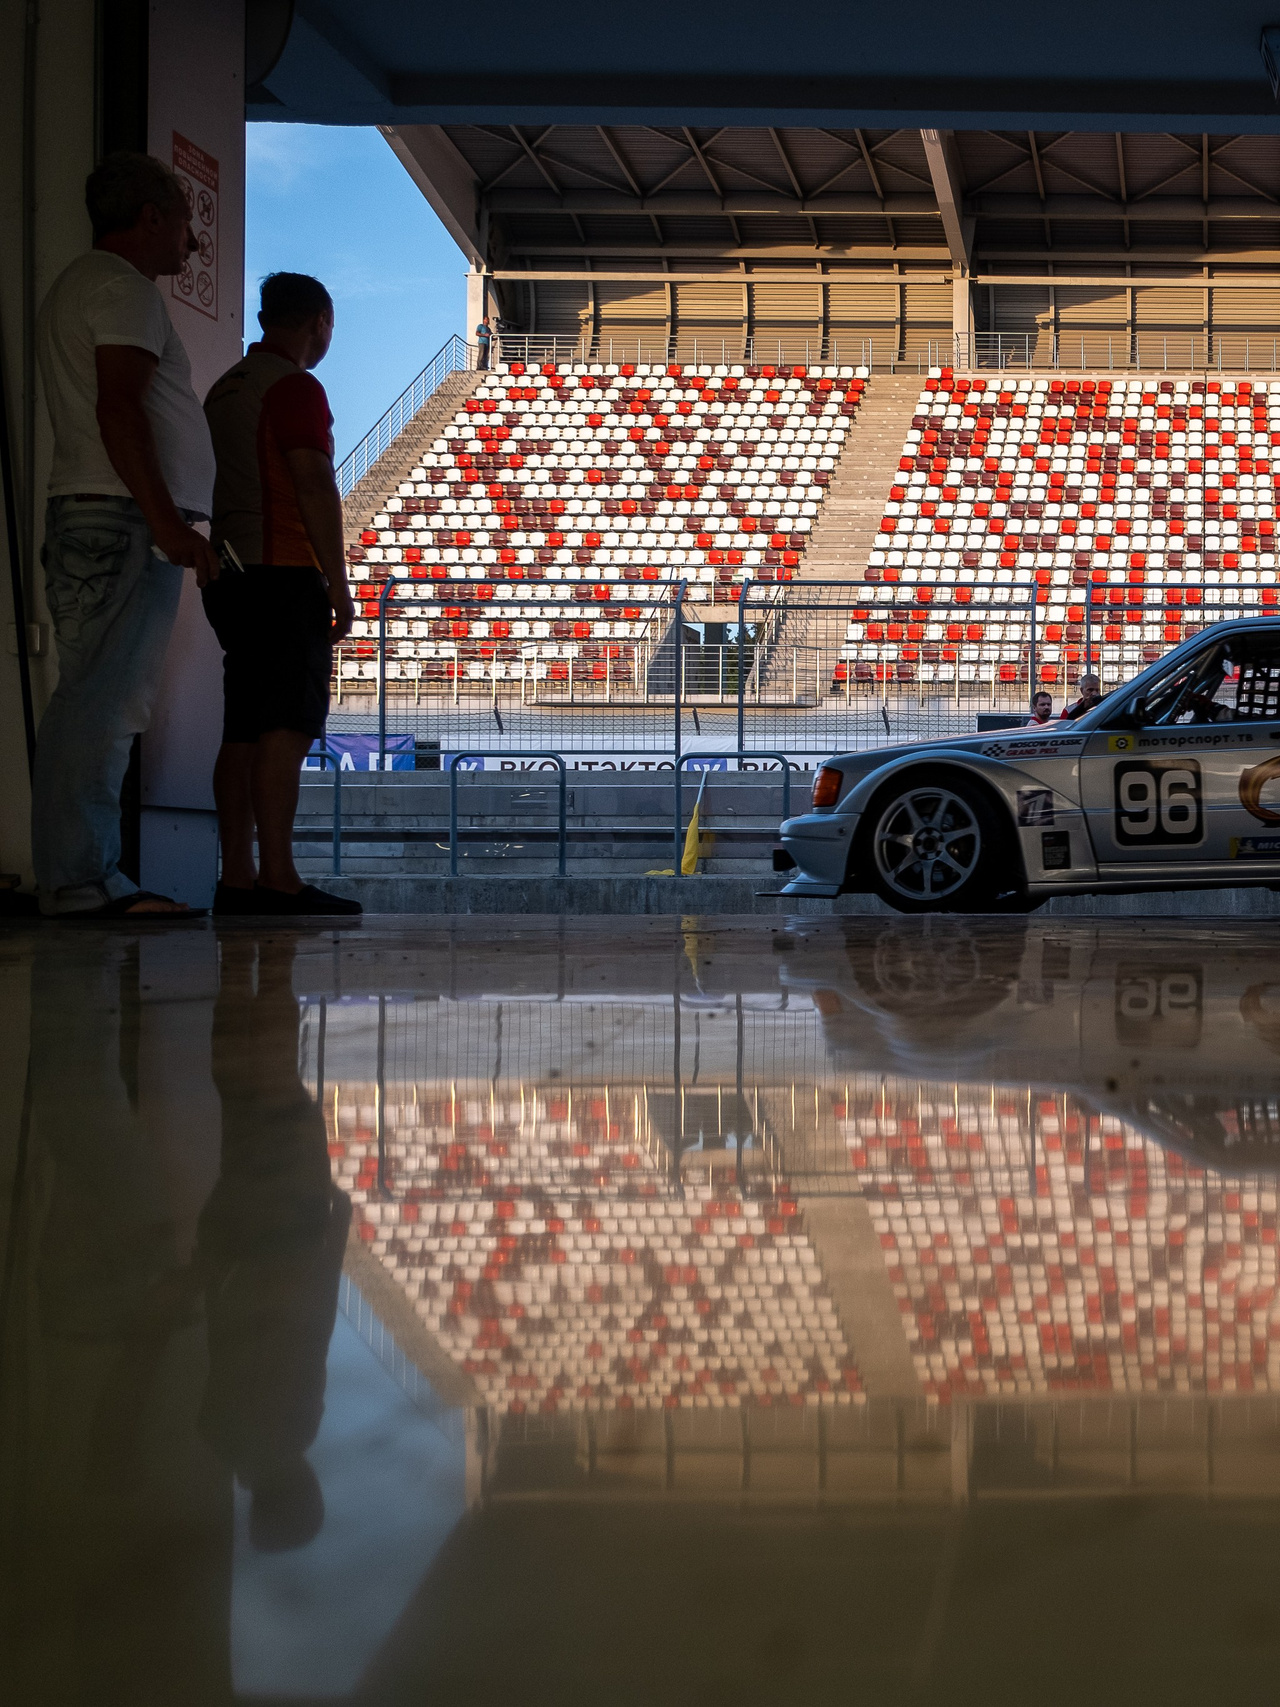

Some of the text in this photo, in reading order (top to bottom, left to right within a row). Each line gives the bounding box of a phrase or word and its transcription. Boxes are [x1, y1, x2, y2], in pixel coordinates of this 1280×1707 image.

[174, 144, 218, 181] ПОВЫШЕННОЙ
[188, 145, 205, 162] ЗОНА
[178, 156, 215, 187] ОПАСНОСТИ
[1006, 748, 1037, 757] GRAND
[1009, 738, 1083, 748] MOSCOW CLASSIC
[1120, 770, 1197, 835] 96
